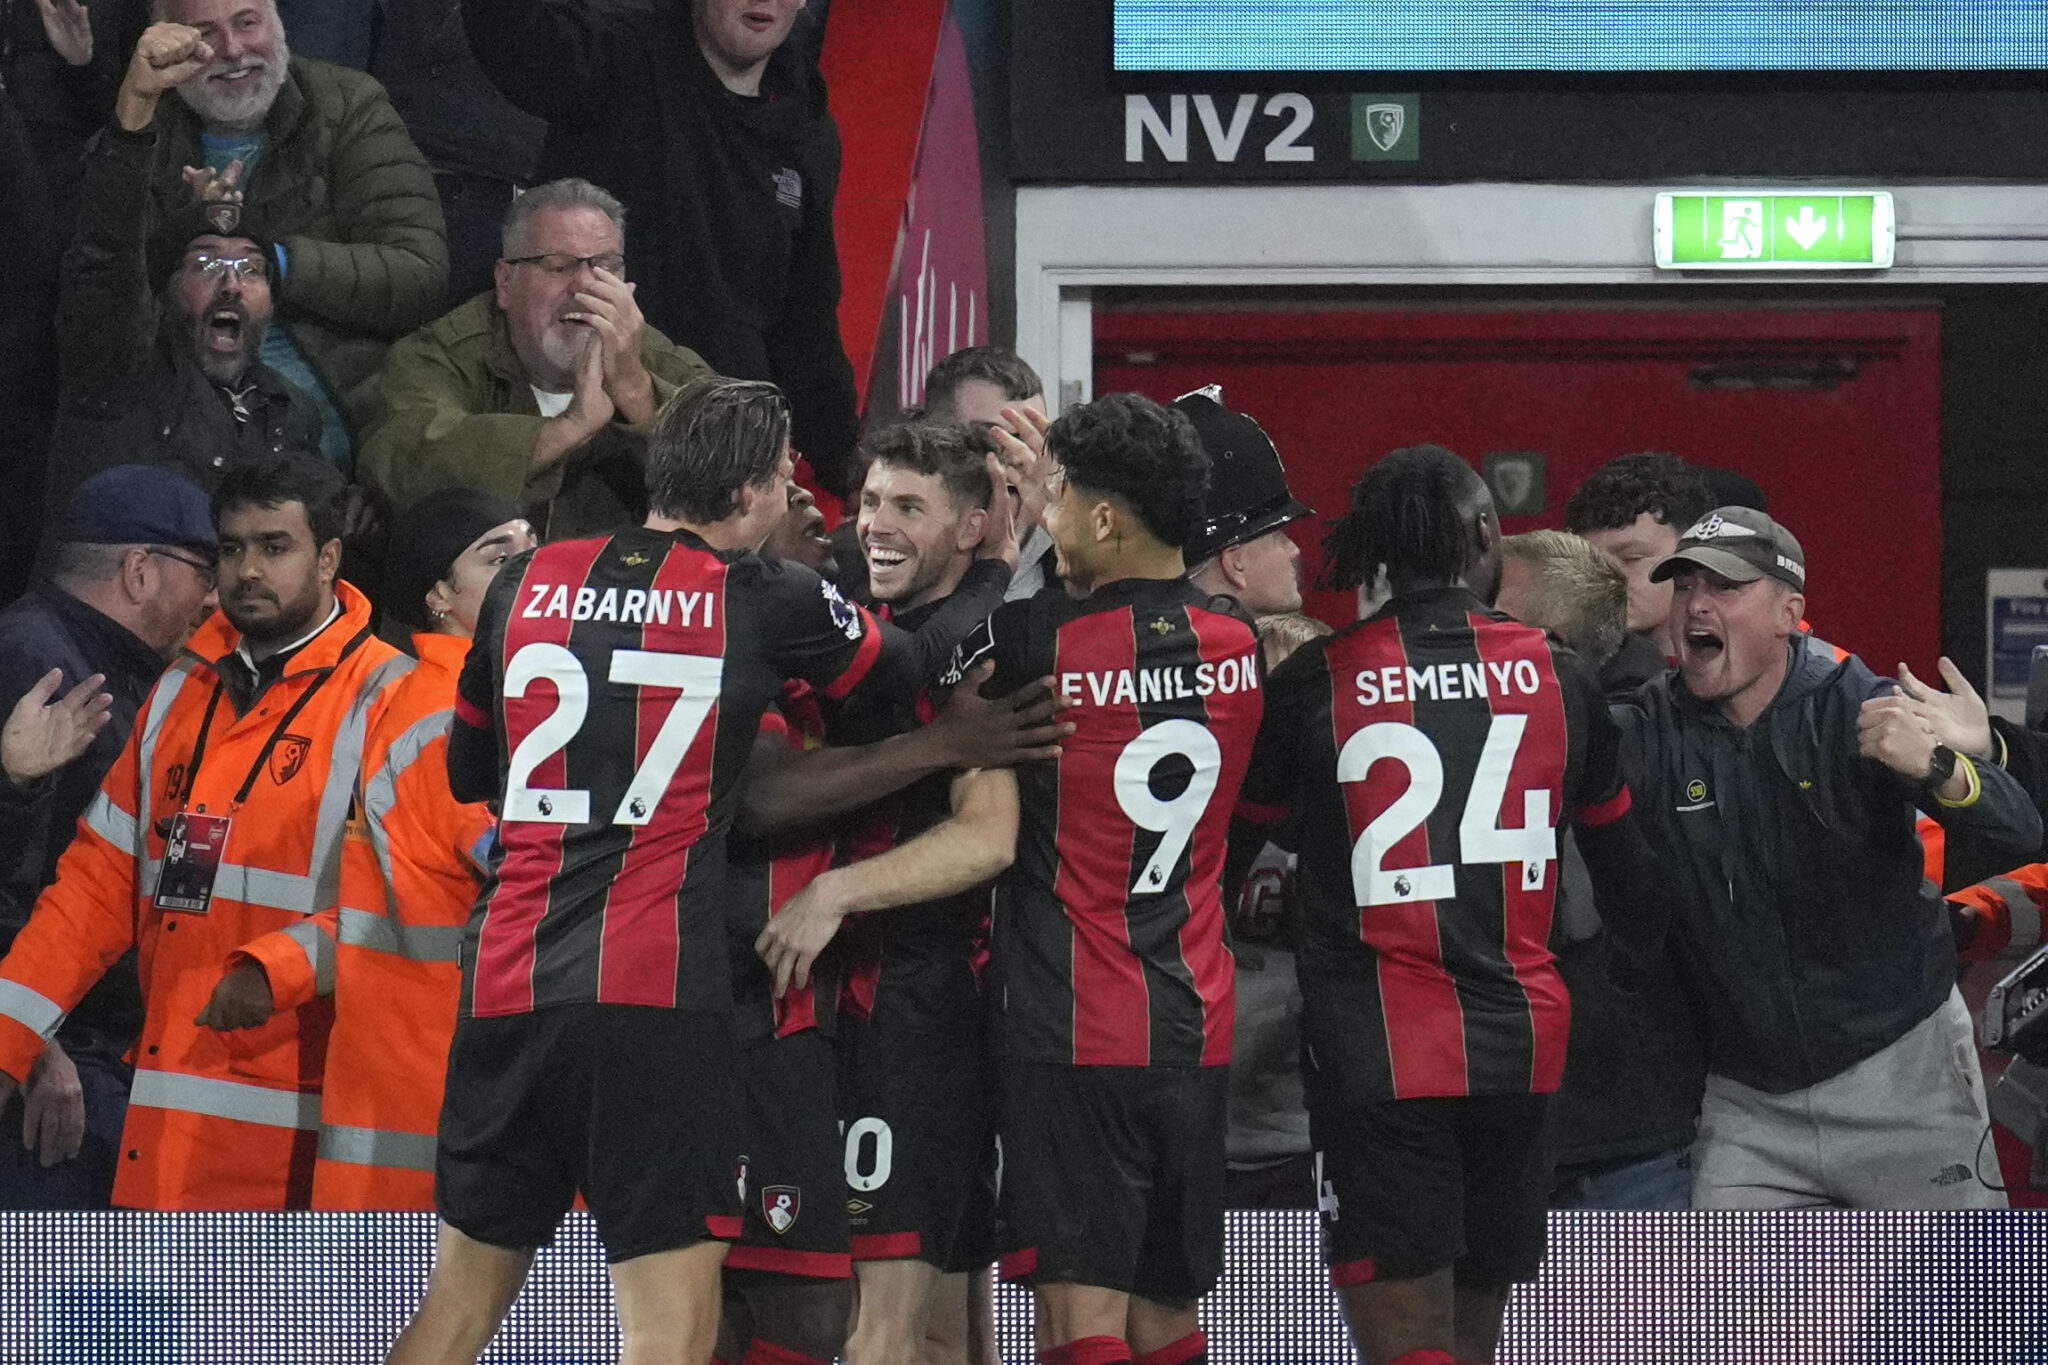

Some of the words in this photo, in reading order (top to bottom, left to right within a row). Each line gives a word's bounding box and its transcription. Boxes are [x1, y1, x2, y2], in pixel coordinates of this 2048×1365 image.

[1125, 92, 1314, 162] NV2
[522, 584, 714, 628] ZABARNYI
[1061, 654, 1258, 707] EVANILSON
[1356, 659, 1540, 706] SEMENYO
[503, 641, 725, 825] 27
[1114, 718, 1222, 893] 9
[1337, 713, 1557, 907] 24
[838, 1116, 892, 1192] 0
